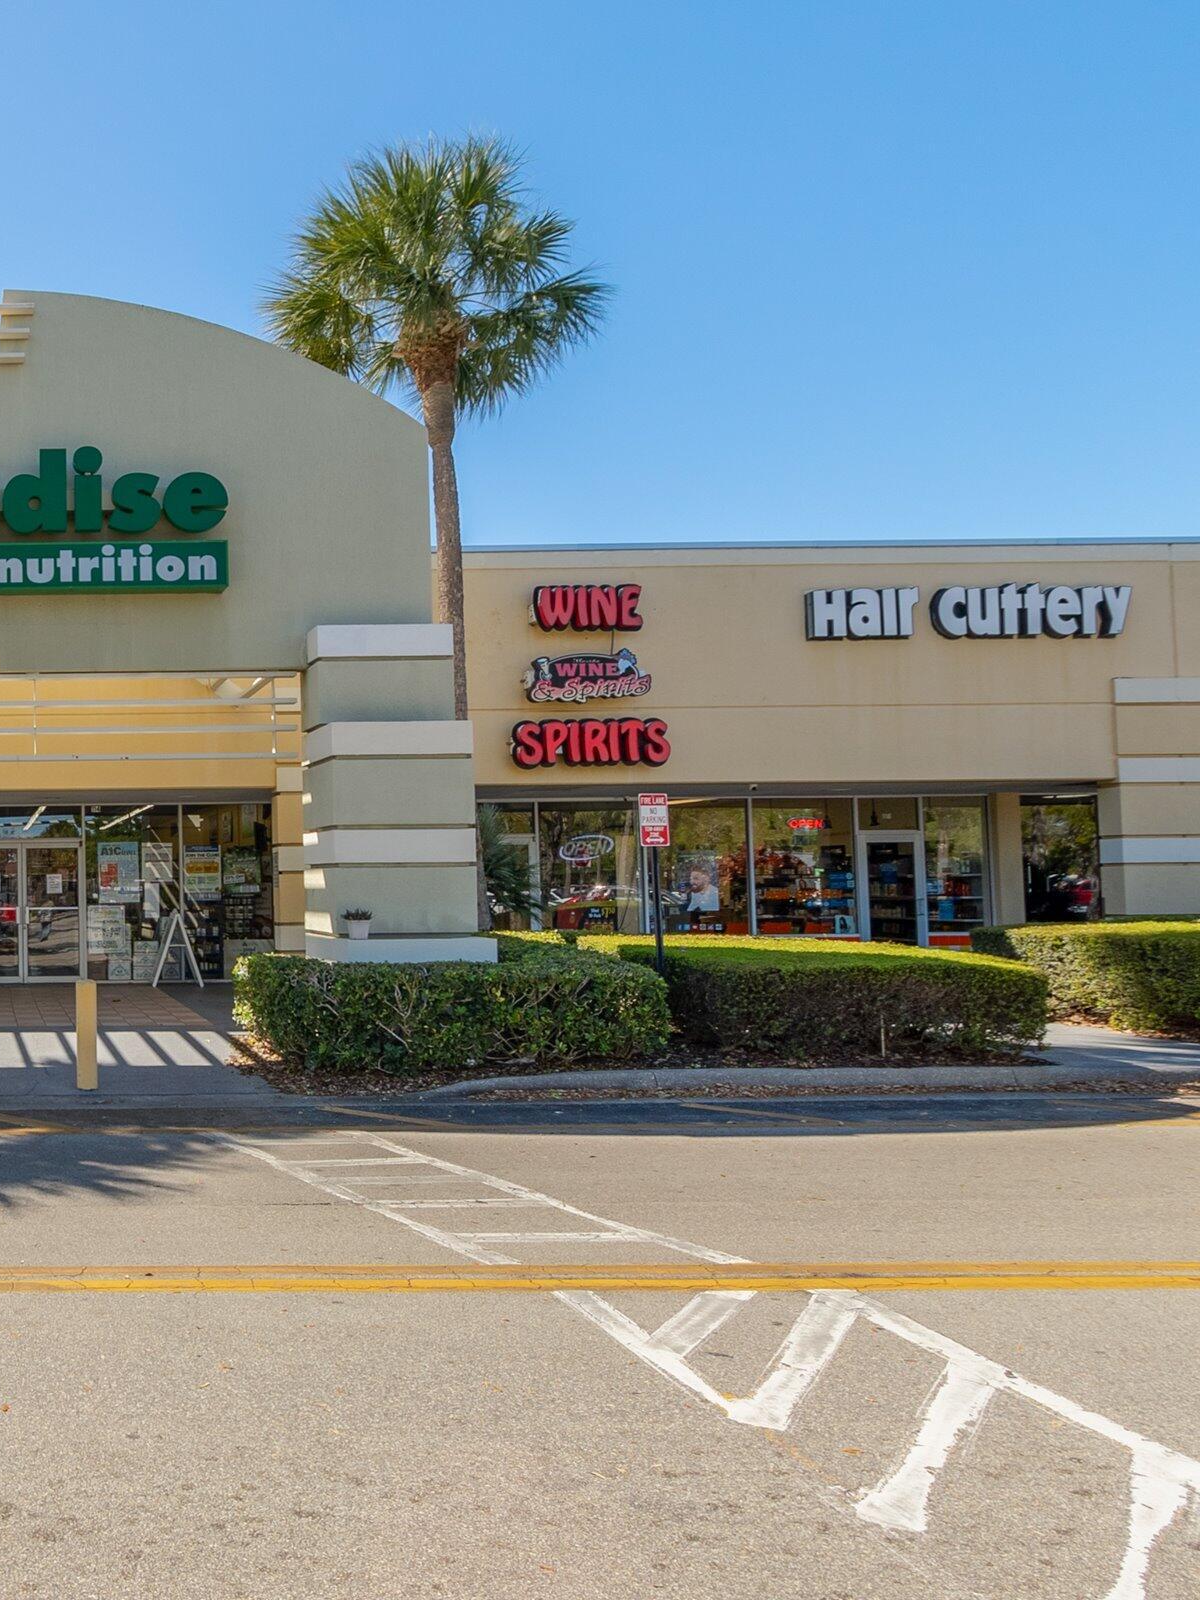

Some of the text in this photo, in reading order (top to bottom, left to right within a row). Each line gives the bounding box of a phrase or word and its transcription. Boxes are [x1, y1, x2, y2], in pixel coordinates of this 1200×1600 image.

[535, 584, 643, 632] WINE
[804, 586, 920, 640] Hair
[554, 662, 621, 678] WINE
[532, 673, 651, 702] & Spirits
[514, 718, 671, 768] SPIRITS
[642, 816, 667, 824] PARKING
[649, 807, 658, 815] NO
[789, 818, 825, 829] OPEN
[563, 839, 609, 857] OPEN
